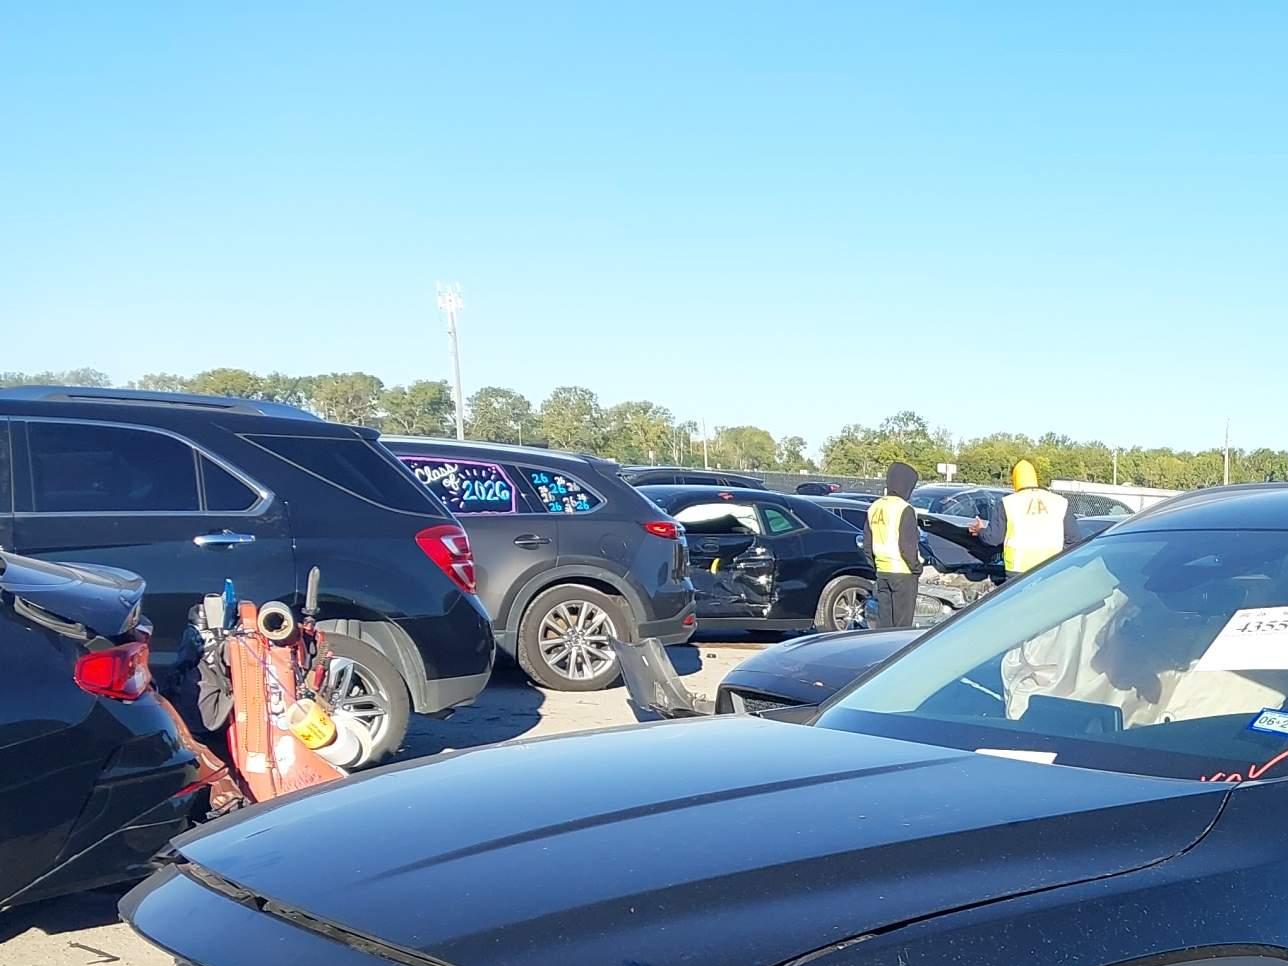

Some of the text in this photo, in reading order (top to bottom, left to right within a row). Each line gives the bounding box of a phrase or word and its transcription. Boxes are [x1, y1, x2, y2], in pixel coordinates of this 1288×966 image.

[415, 464, 459, 485] Class
[531, 473, 549, 484] 26
[442, 473, 460, 491] of
[462, 480, 510, 501] 2026
[549, 483, 567, 494] 26
[548, 502, 563, 512] 26
[576, 500, 590, 510] 26
